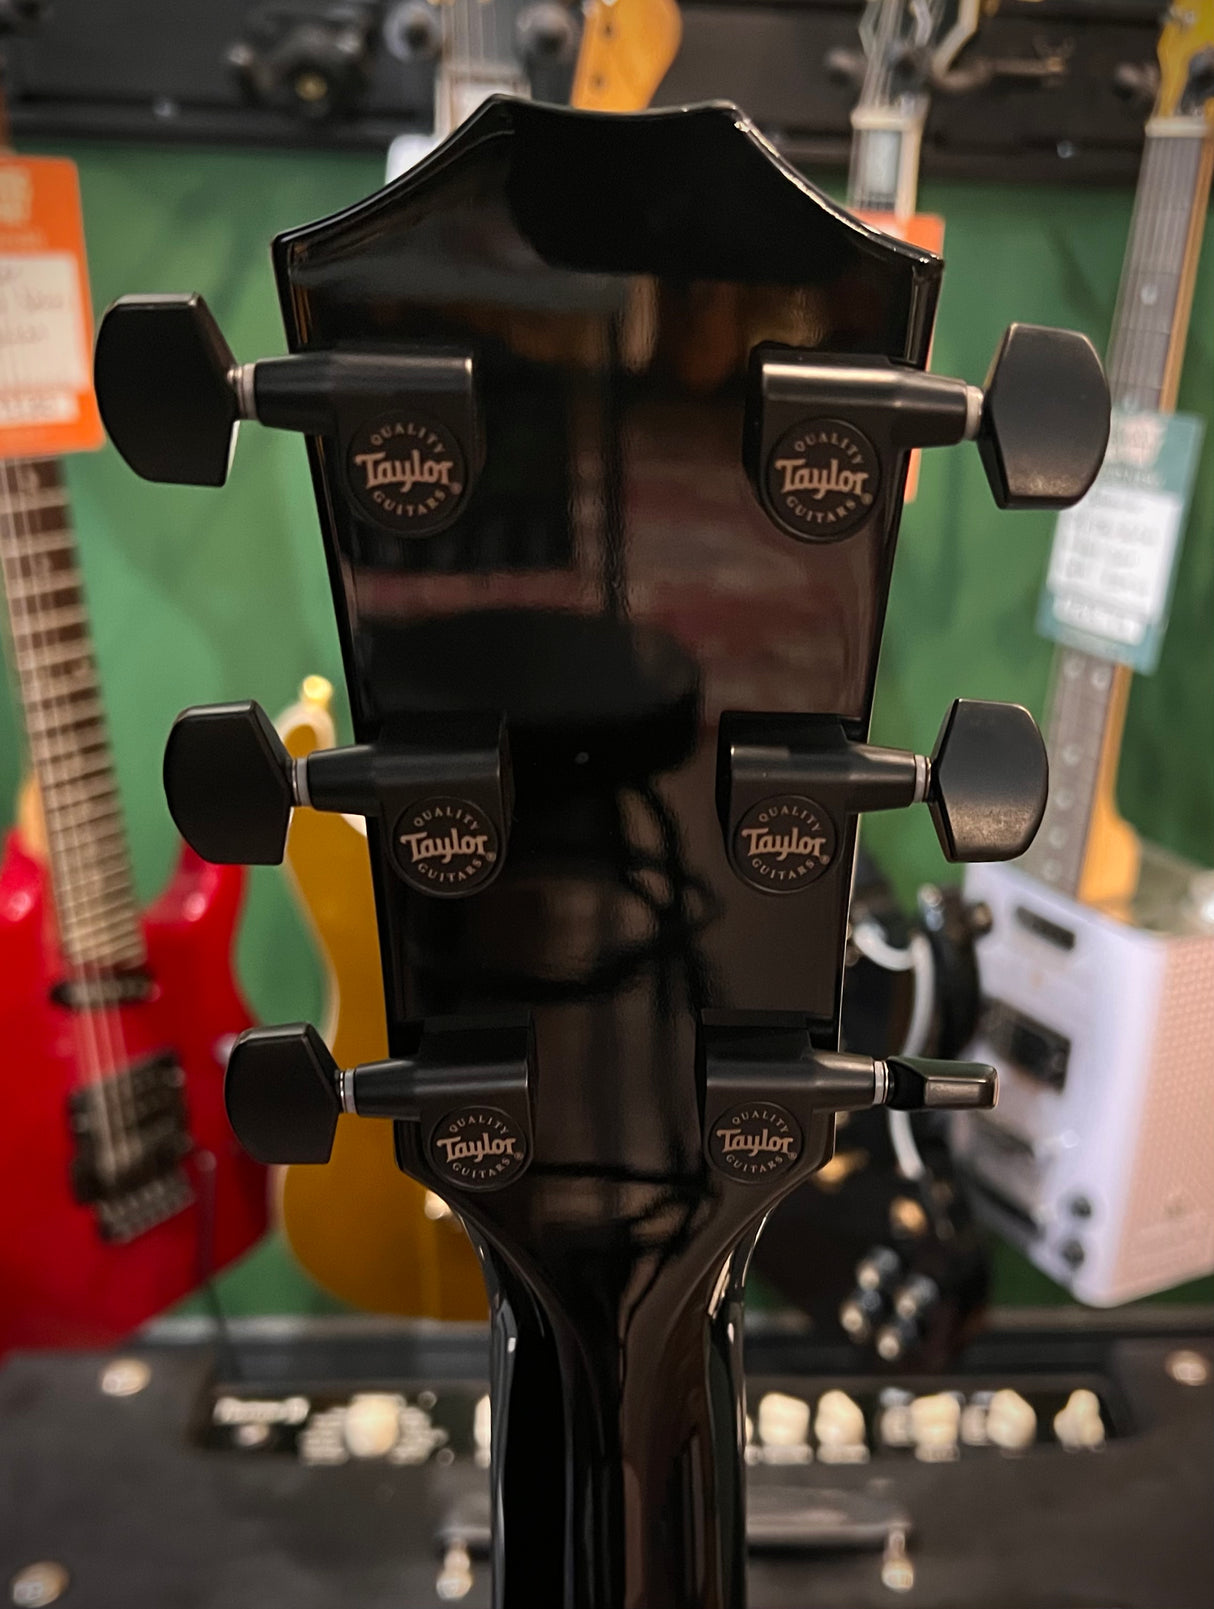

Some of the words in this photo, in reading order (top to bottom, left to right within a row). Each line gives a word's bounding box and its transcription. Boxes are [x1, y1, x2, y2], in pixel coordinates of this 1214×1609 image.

[370, 423, 446, 453] QUALITY
[794, 431, 864, 464] QUALITY
[354, 448, 454, 493] Taylor
[774, 457, 869, 500] Taylor
[373, 490, 446, 517] GUITARS
[786, 496, 856, 523] GUITARS
[414, 806, 478, 830] QUALITY
[758, 805, 821, 831] QUALITY
[400, 827, 488, 864] Taylor
[741, 826, 826, 861] Taylor
[417, 858, 482, 882] GUITARS
[752, 858, 815, 880] GUITARS
[449, 1115, 509, 1134] QUALITY
[732, 1110, 789, 1133] QUALITY
[436, 1132, 516, 1163] Taylor
[716, 1128, 794, 1157] Taylor
[452, 1157, 510, 1178] GUITARS
[726, 1154, 783, 1173] GUITARS
